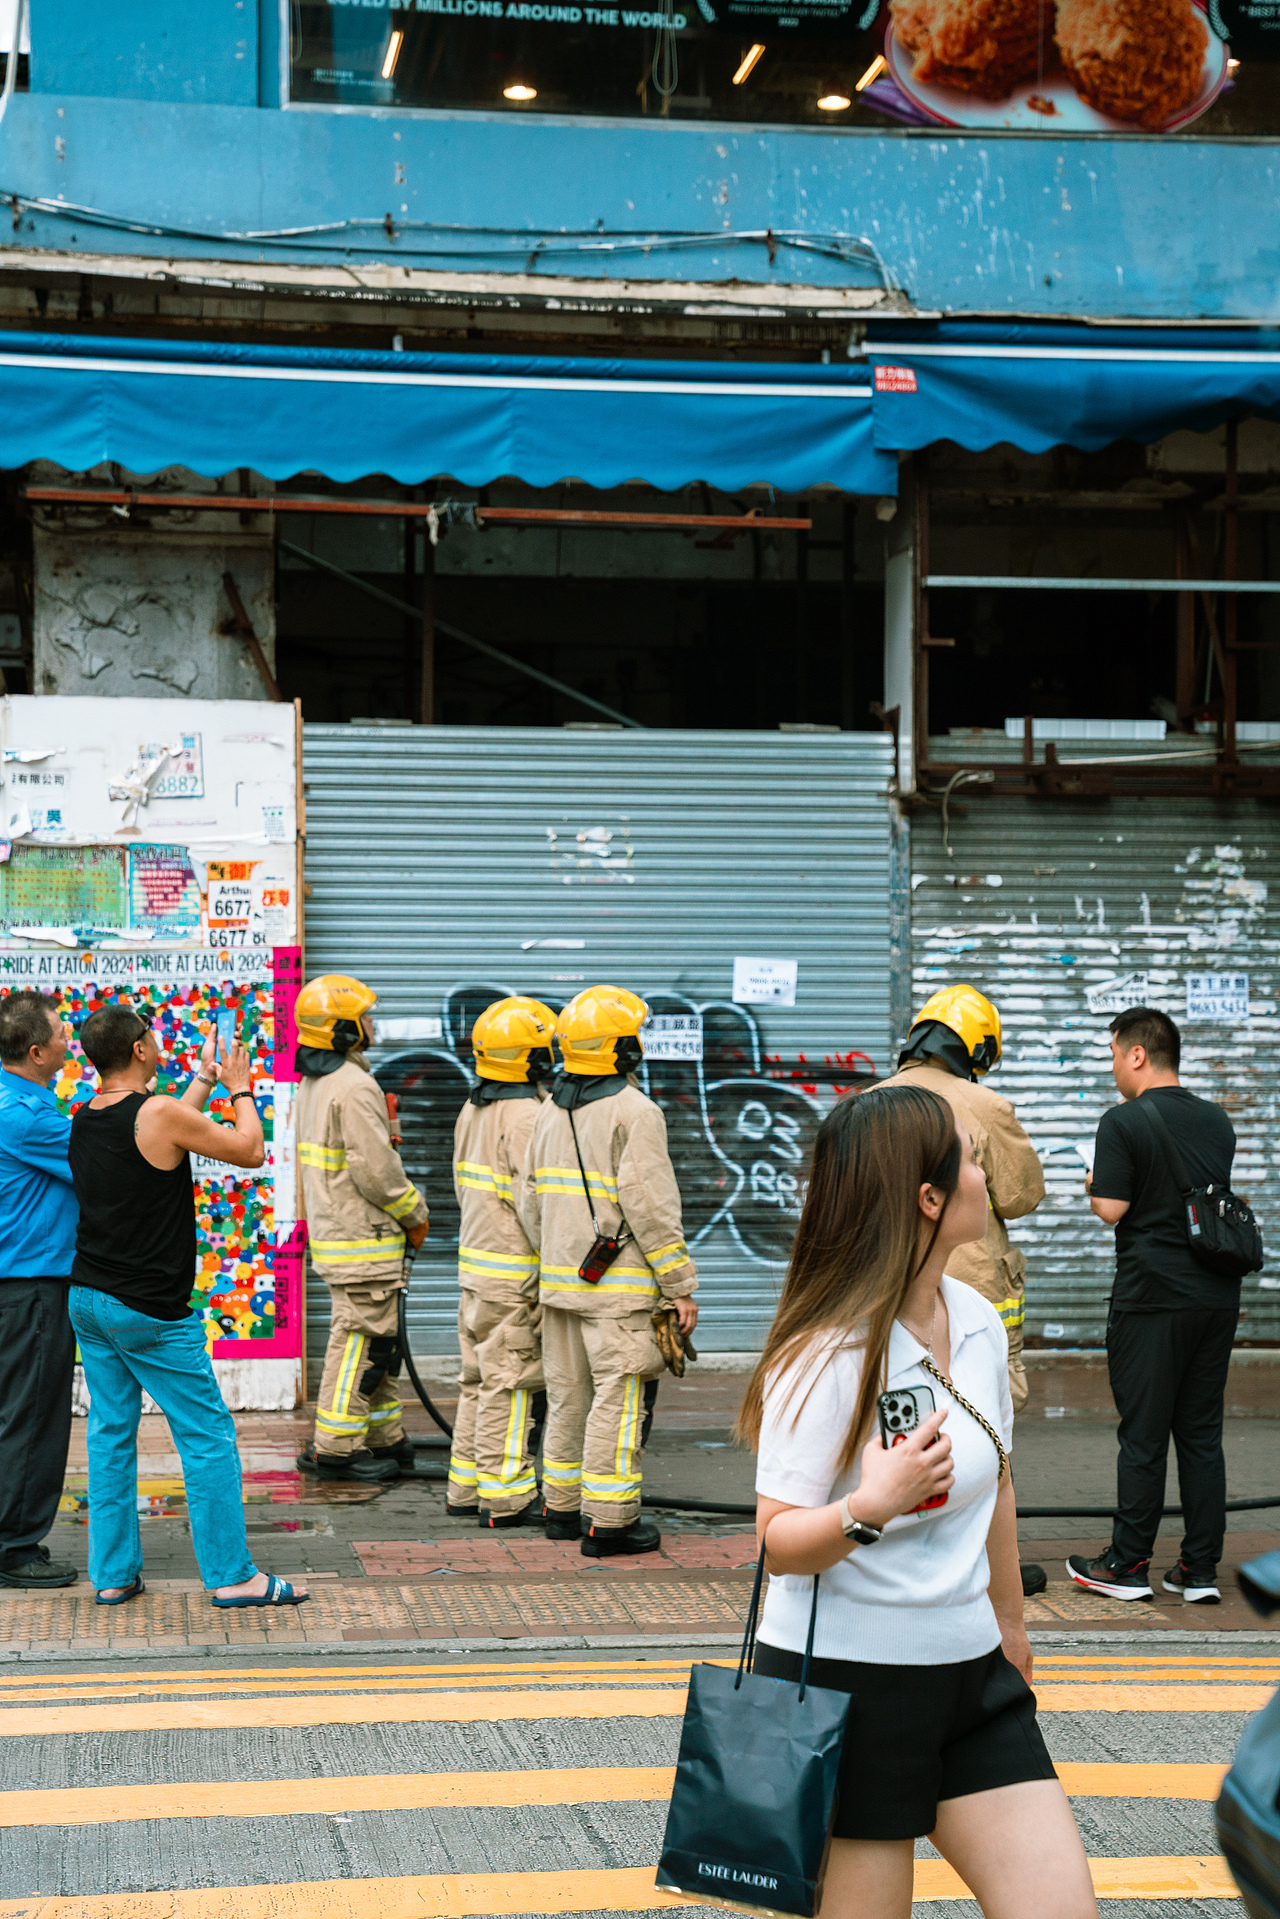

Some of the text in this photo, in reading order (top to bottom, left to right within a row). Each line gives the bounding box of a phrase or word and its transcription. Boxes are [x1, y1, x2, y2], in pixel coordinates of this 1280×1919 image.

[416, 0, 503, 18] MILLIONS
[505, 3, 582, 22] AROUND
[584, 8, 619, 26] THE
[621, 10, 687, 30] WORLD
[215, 900, 251, 917] 6677
[209, 929, 247, 948] 6677
[0, 955, 35, 974] PRIDE
[39, 955, 52, 974] AT
[58, 955, 98, 974] EATON
[136, 954, 171, 973] PRIDE
[176, 954, 190, 973] AT
[195, 954, 235, 973] EATON
[698, 1862, 778, 1891] ESTÉE LAUDER
